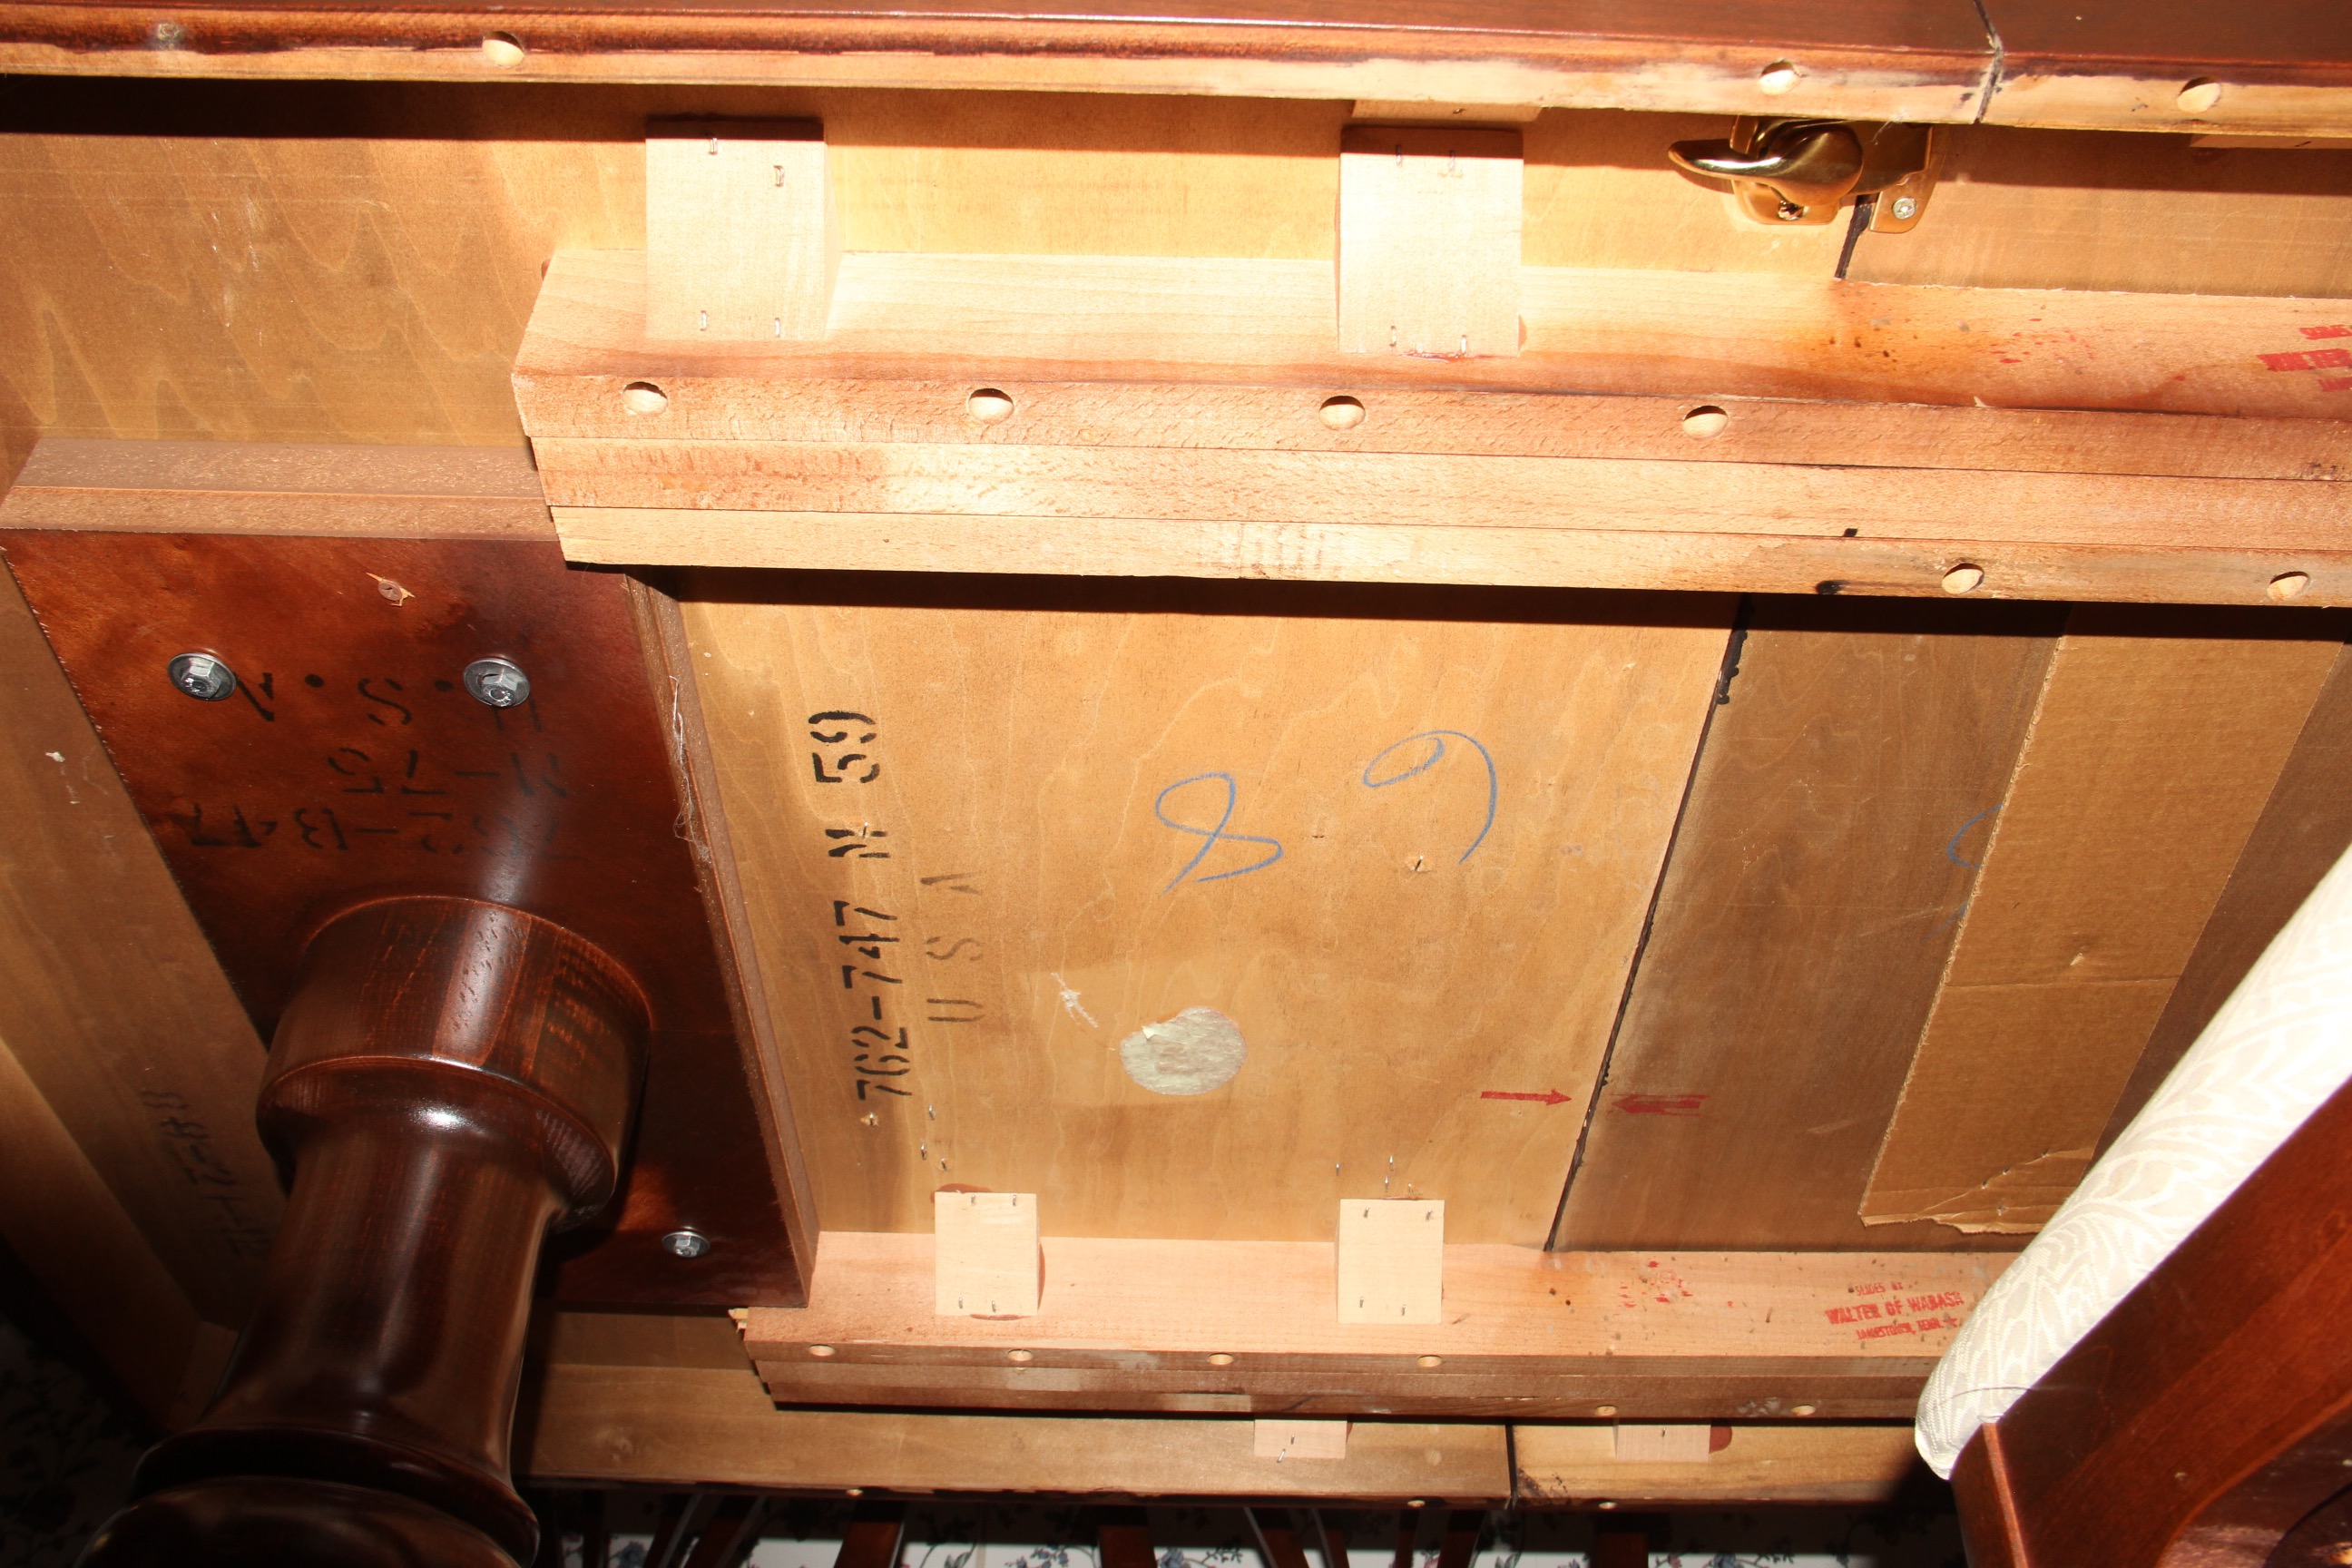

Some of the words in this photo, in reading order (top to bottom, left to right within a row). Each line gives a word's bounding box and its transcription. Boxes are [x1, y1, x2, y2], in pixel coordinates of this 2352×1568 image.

[808, 710, 880, 783] 59
[834, 900, 912, 1101] 762-747
[1825, 1304, 1882, 1324] WALTER
[1885, 1299, 1904, 1316] OF
